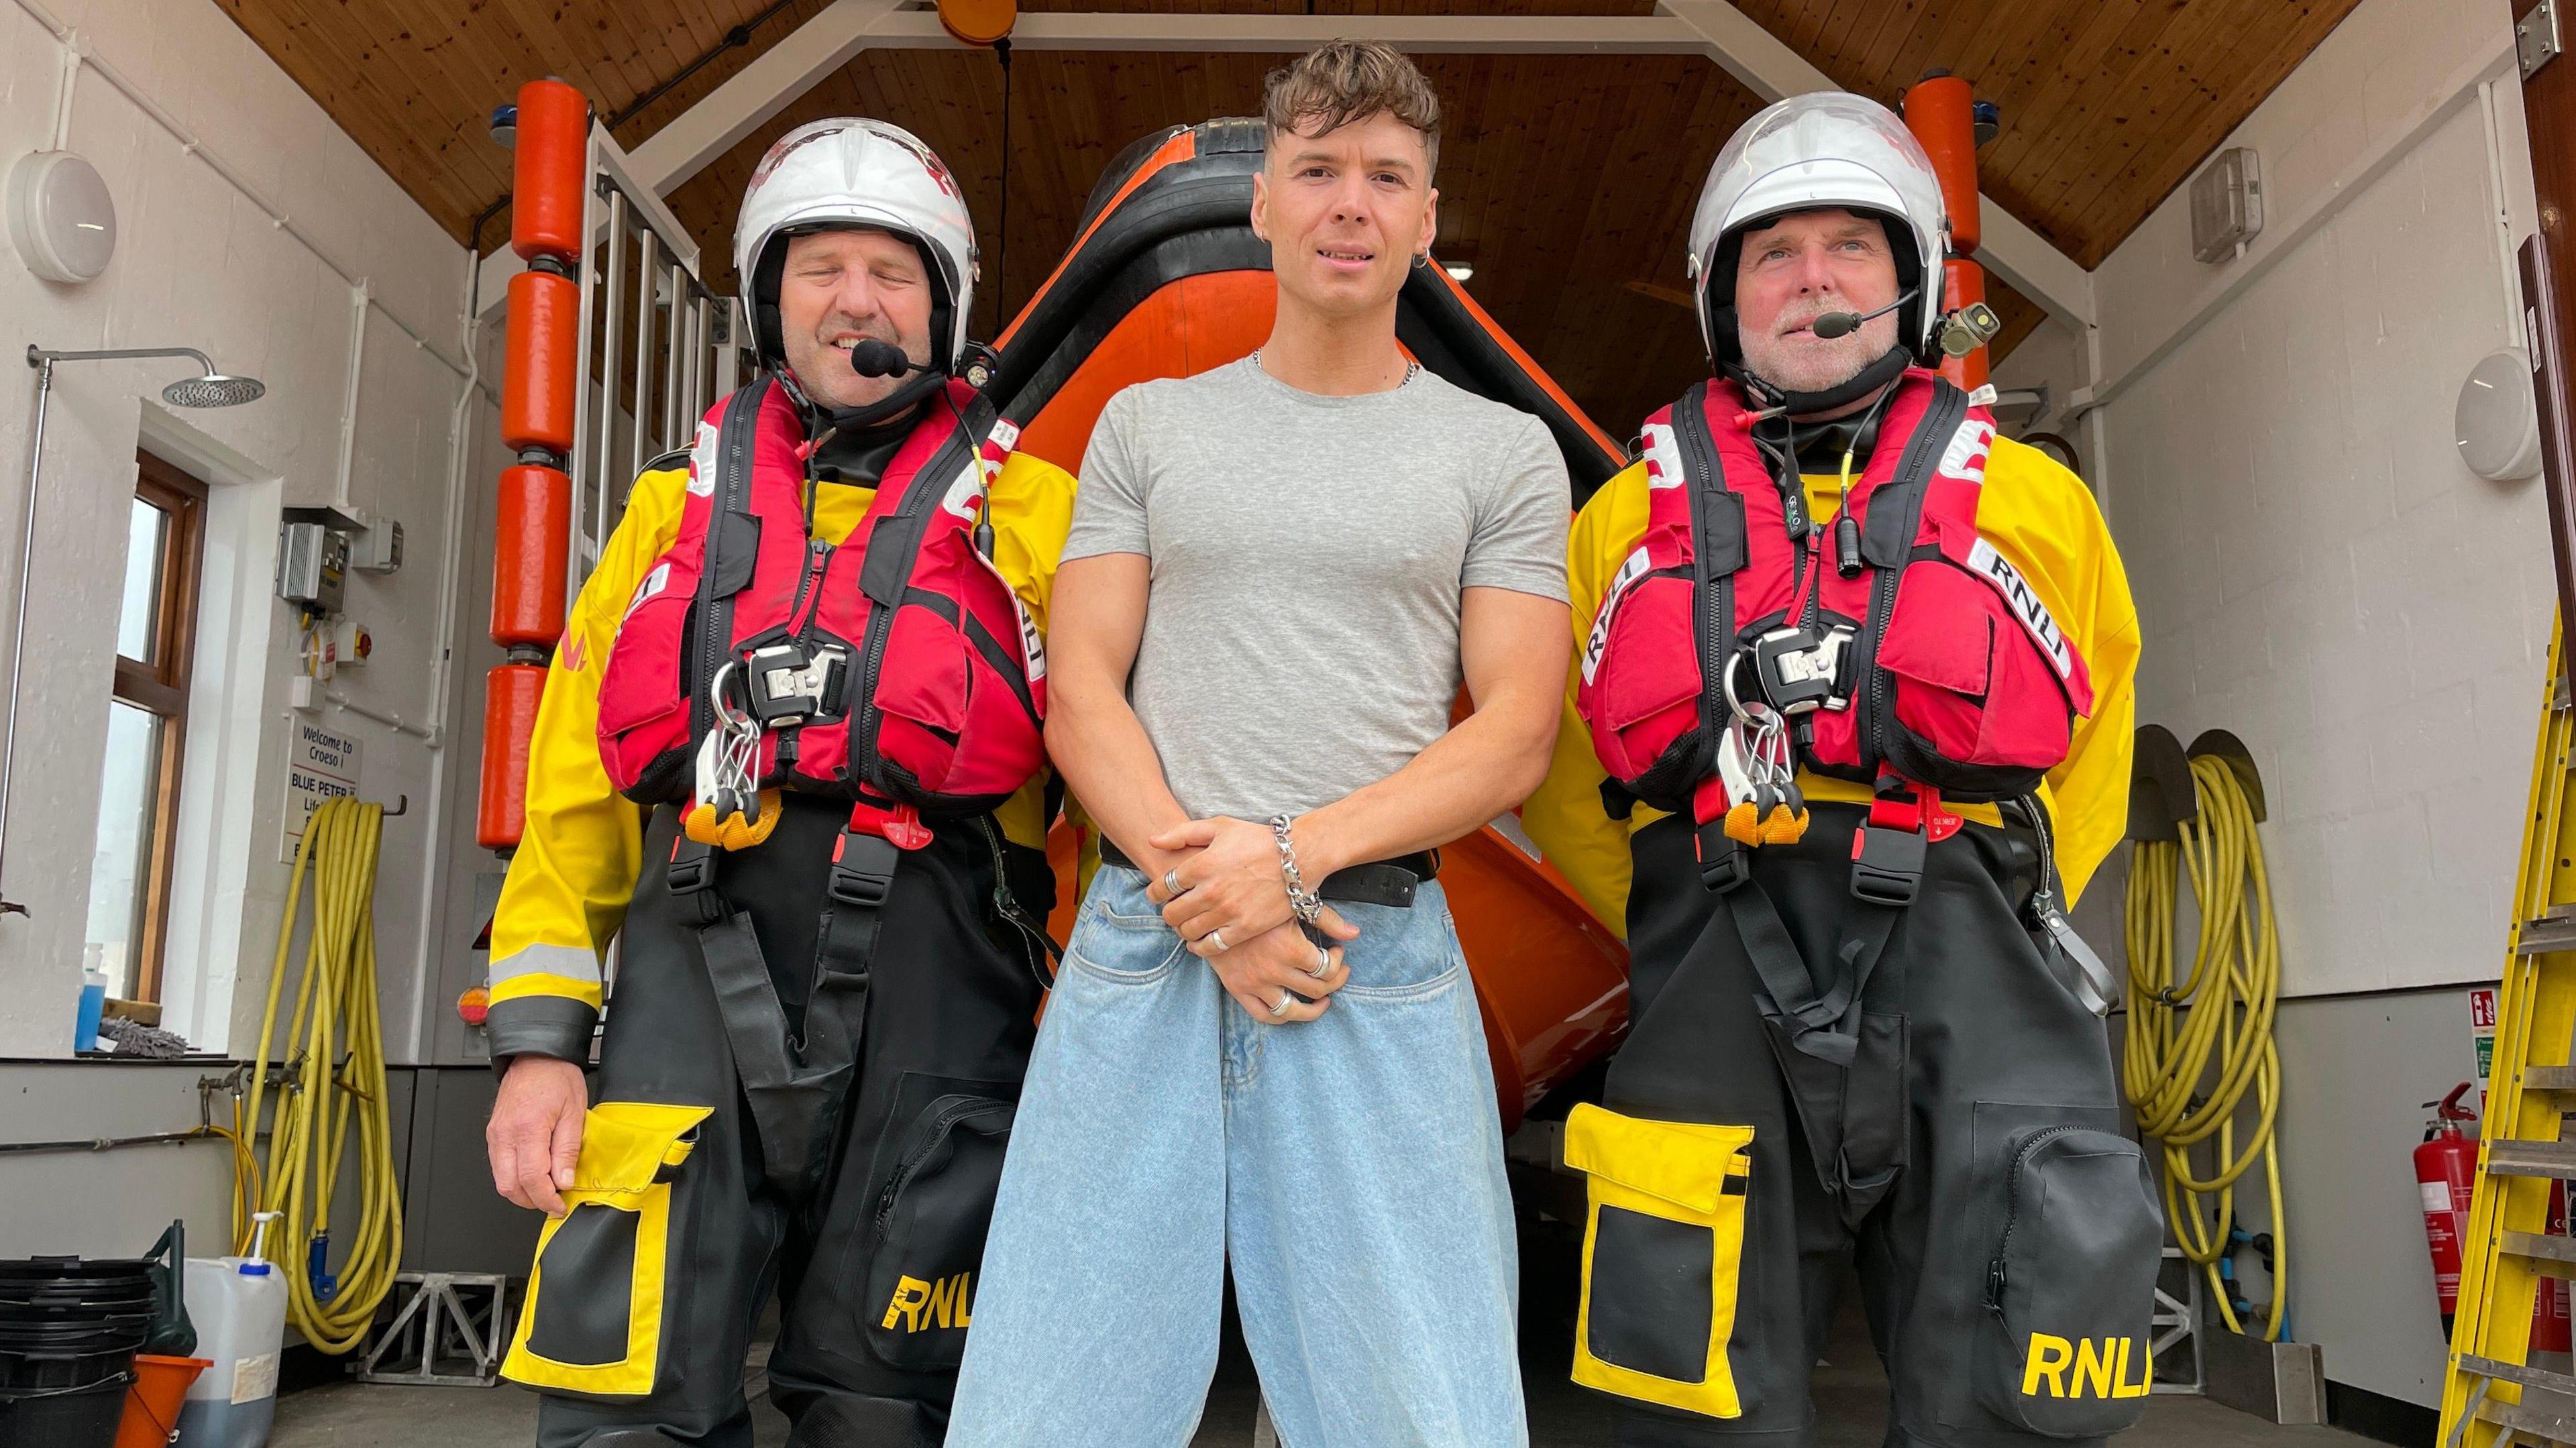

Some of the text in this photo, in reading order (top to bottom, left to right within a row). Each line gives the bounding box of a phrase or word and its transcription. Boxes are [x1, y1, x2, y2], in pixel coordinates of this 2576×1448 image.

[1015, 592, 1042, 662] NLI
[1990, 554, 2063, 657] RNLI
[304, 726, 352, 754] Welcome to
[309, 746, 345, 769] Croeso i
[292, 773, 315, 791] BLUE
[319, 781, 347, 797] PETER
[881, 1272, 972, 1334] RNL
[2021, 1330, 2152, 1399] RNLI
